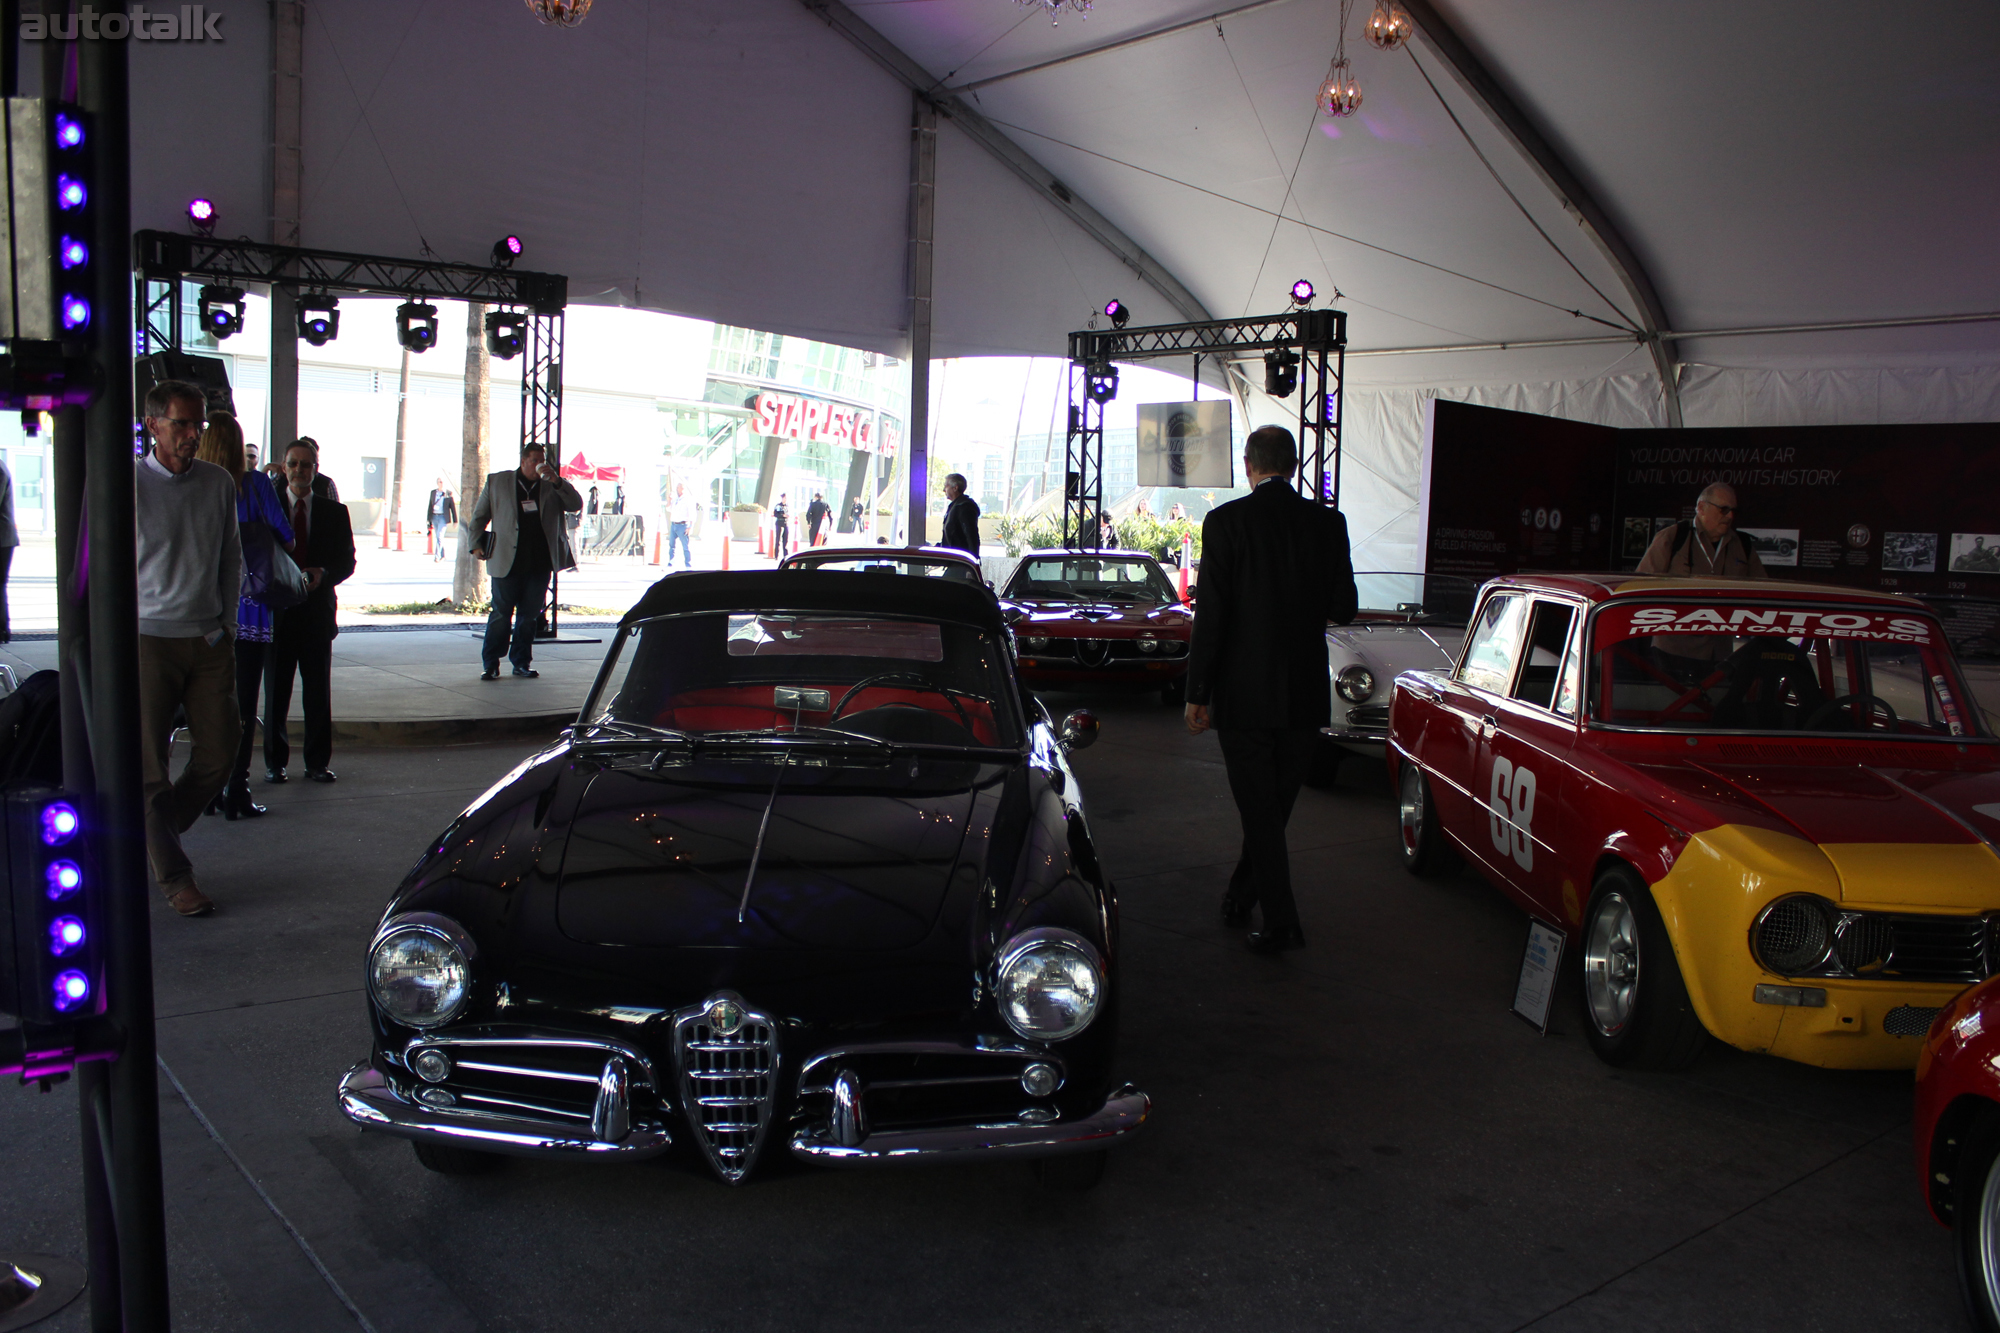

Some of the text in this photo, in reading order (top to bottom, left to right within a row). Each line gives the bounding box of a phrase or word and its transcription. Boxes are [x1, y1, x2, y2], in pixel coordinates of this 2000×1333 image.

[752, 391, 854, 449] STAPLES
[1630, 446, 1795, 463] YOU DON'T KNOW A CAR
[1628, 469, 1842, 486] UNTIL YOU KNOW ITS HISTORY.
[1441, 529, 1468, 540] DRIVING
[1468, 529, 1495, 541] PASSION
[1434, 540, 1507, 553] FUELED AT FINISH LINES
[1880, 578, 1898, 586] 1928
[1948, 581, 1966, 590] 1929
[1630, 608, 1929, 636] SANTO'S
[1629, 623, 1931, 644] ITALIAN CAR SERVICE
[1489, 755, 1537, 874] 68
